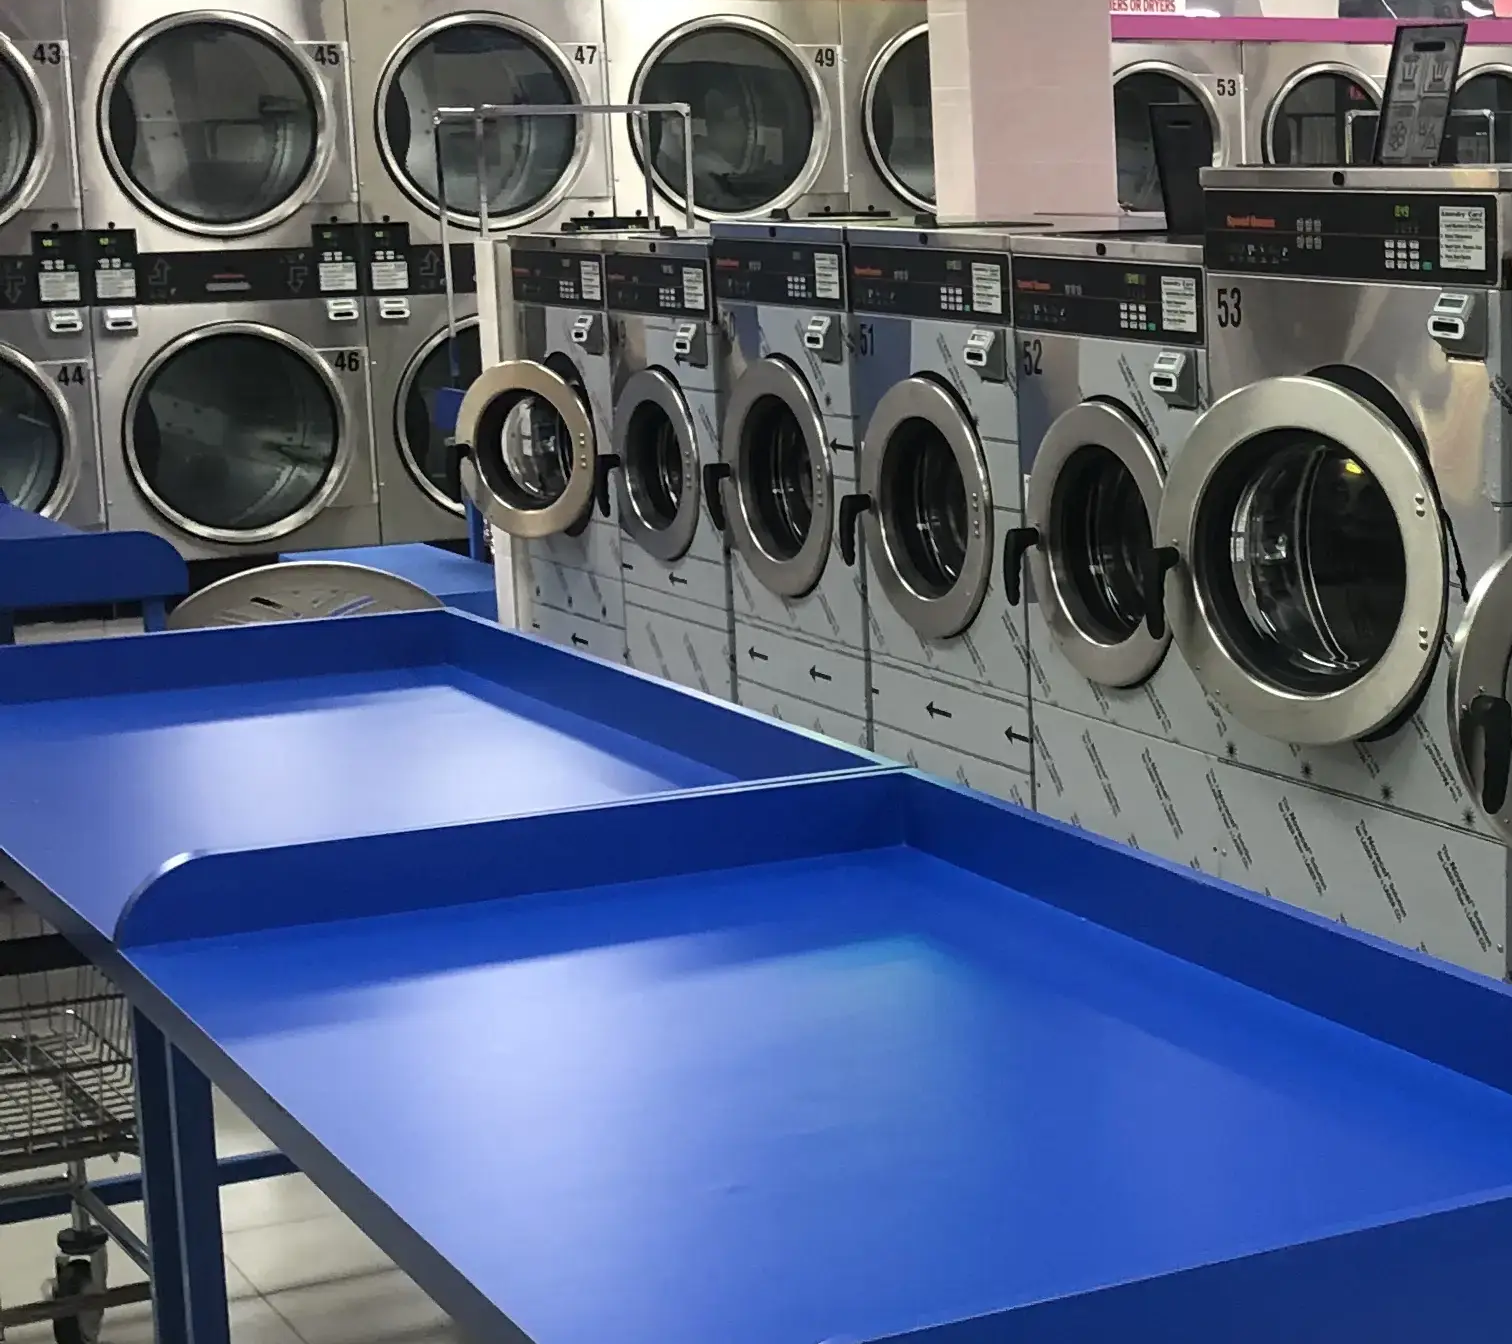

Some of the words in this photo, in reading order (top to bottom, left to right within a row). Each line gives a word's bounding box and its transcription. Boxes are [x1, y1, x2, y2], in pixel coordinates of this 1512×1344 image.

[33, 43, 61, 65] 43
[313, 44, 340, 66] 45
[573, 44, 598, 65] 47
[813, 47, 835, 69] 49
[1215, 78, 1238, 97] 53
[1217, 287, 1242, 328] 53
[860, 323, 874, 357] 51
[334, 351, 360, 372] 46
[1023, 339, 1043, 376] 52
[57, 365, 84, 387] 44
